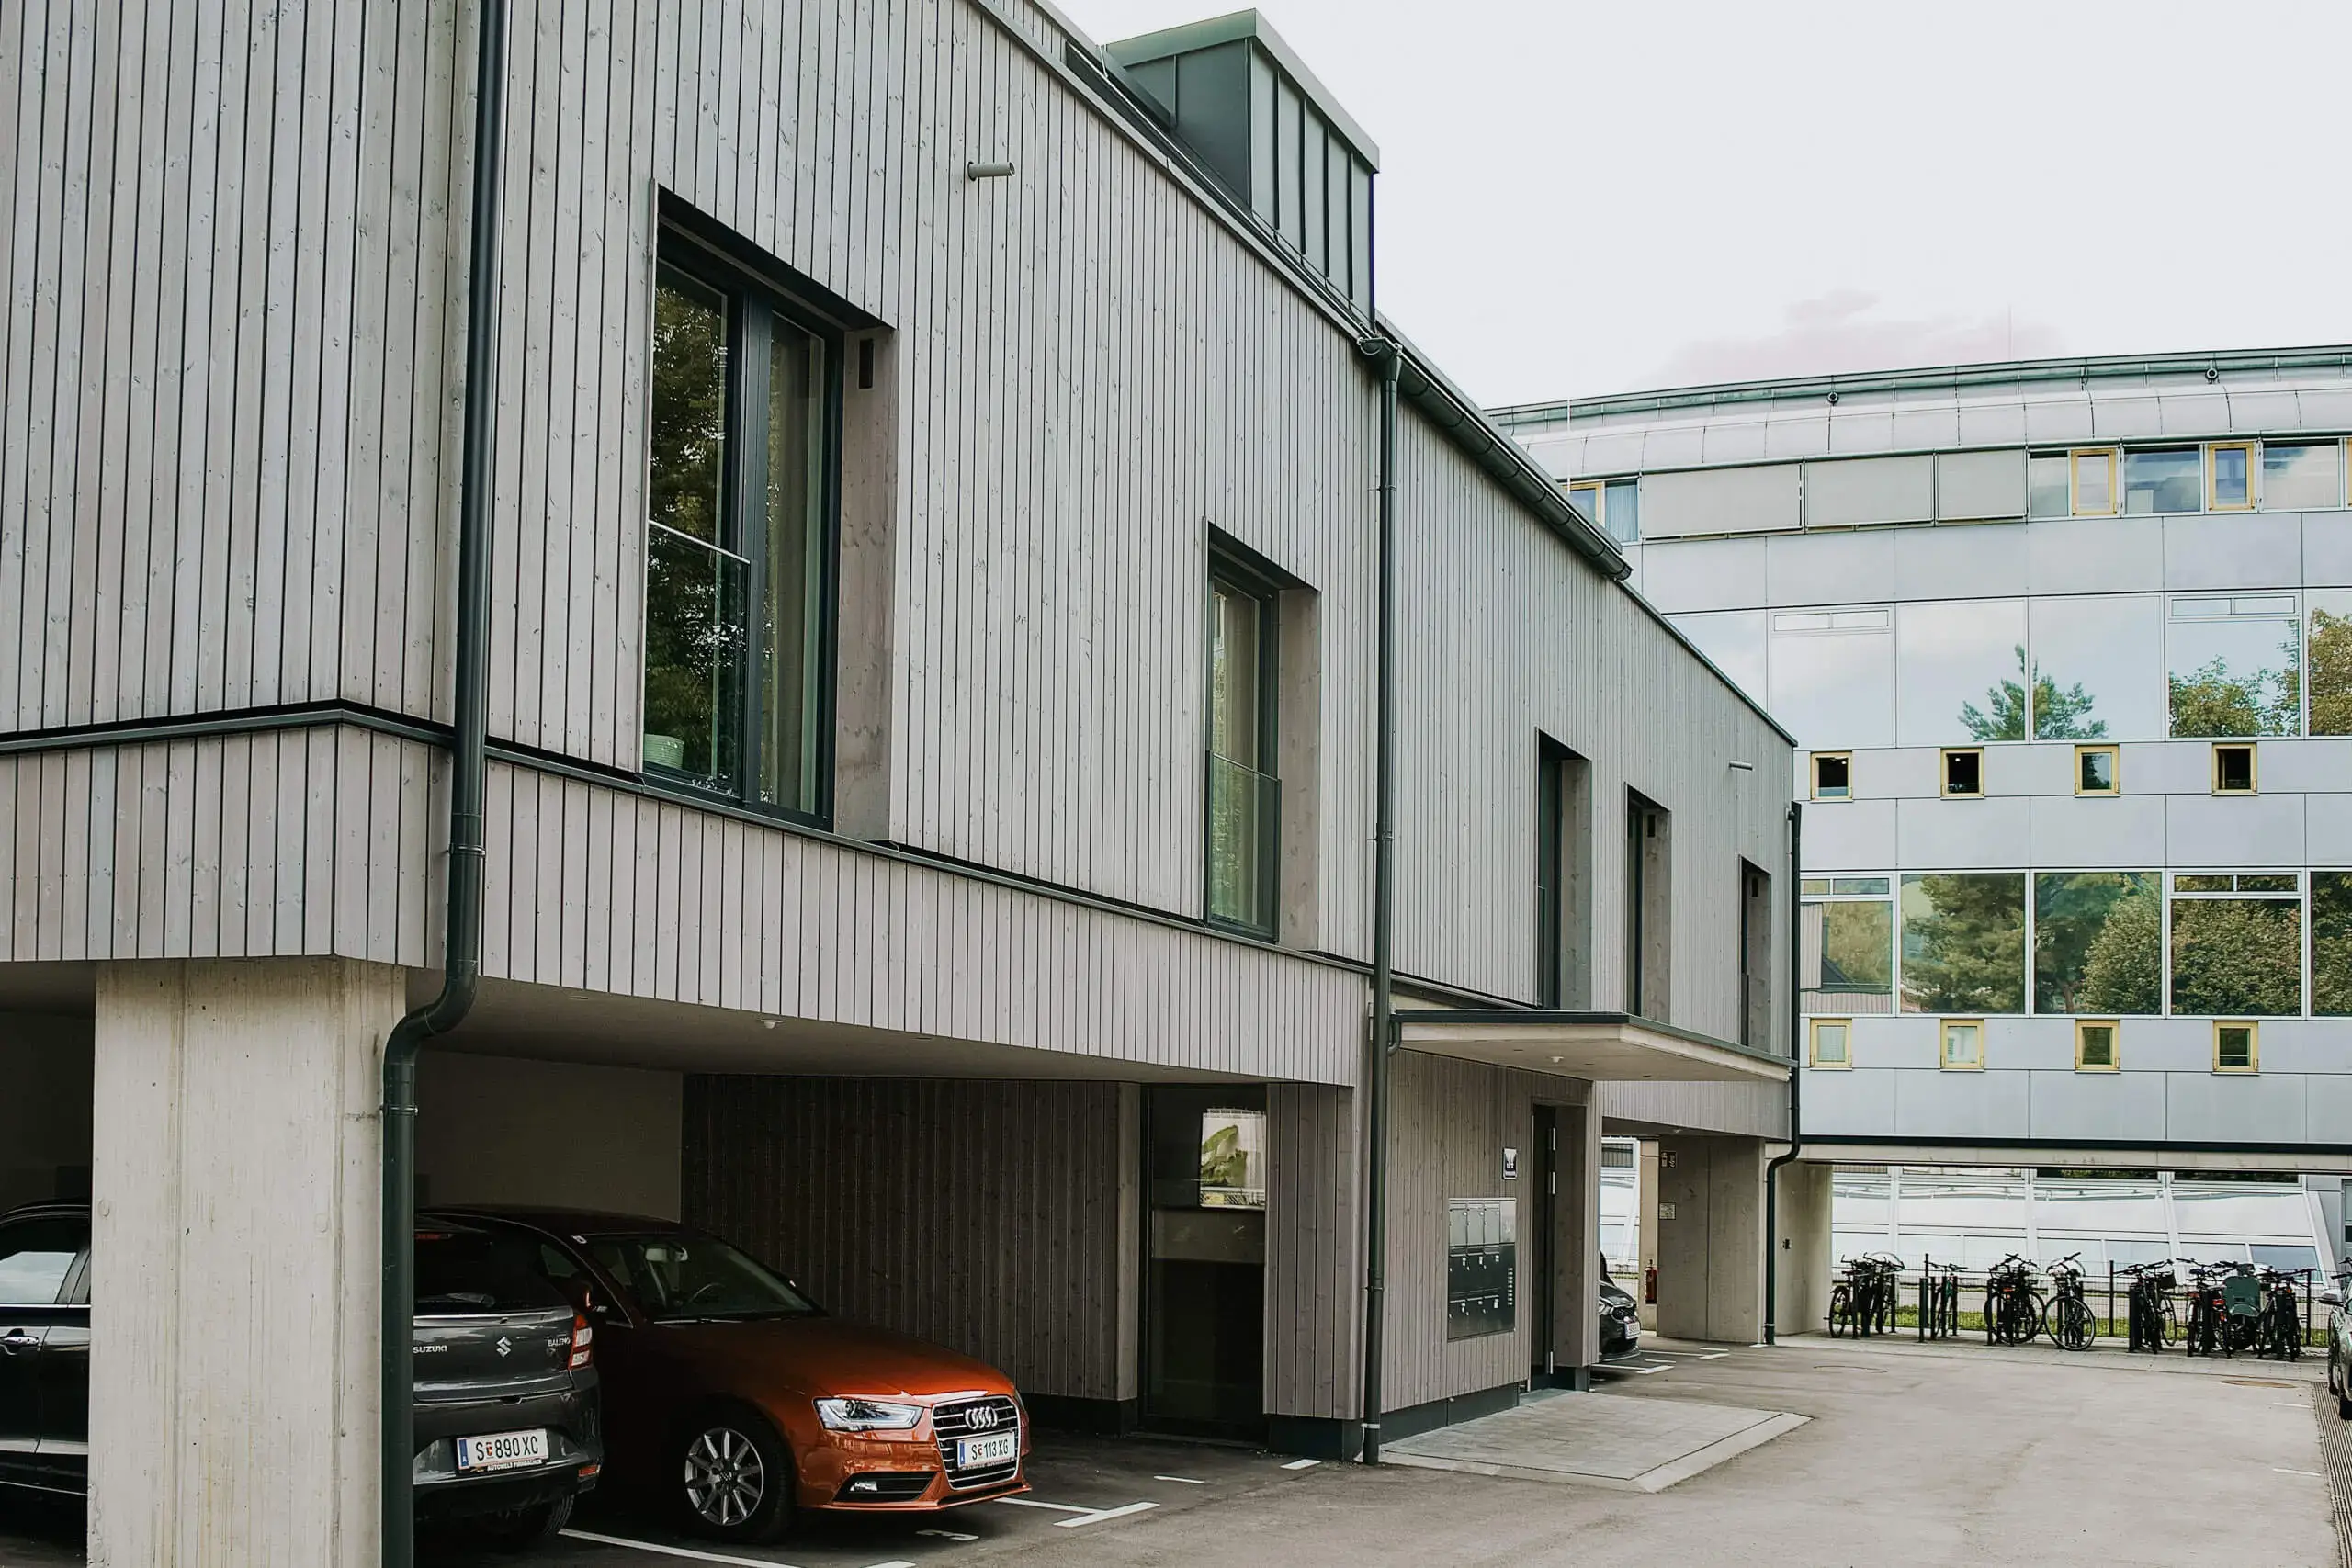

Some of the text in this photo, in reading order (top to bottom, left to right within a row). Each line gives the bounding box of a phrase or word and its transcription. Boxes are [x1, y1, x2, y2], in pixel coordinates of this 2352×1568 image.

[413, 1345, 447, 1354] SUZUKI
[476, 1436, 538, 1461] S 890 XC
[971, 1438, 1009, 1461] S 113 XG
